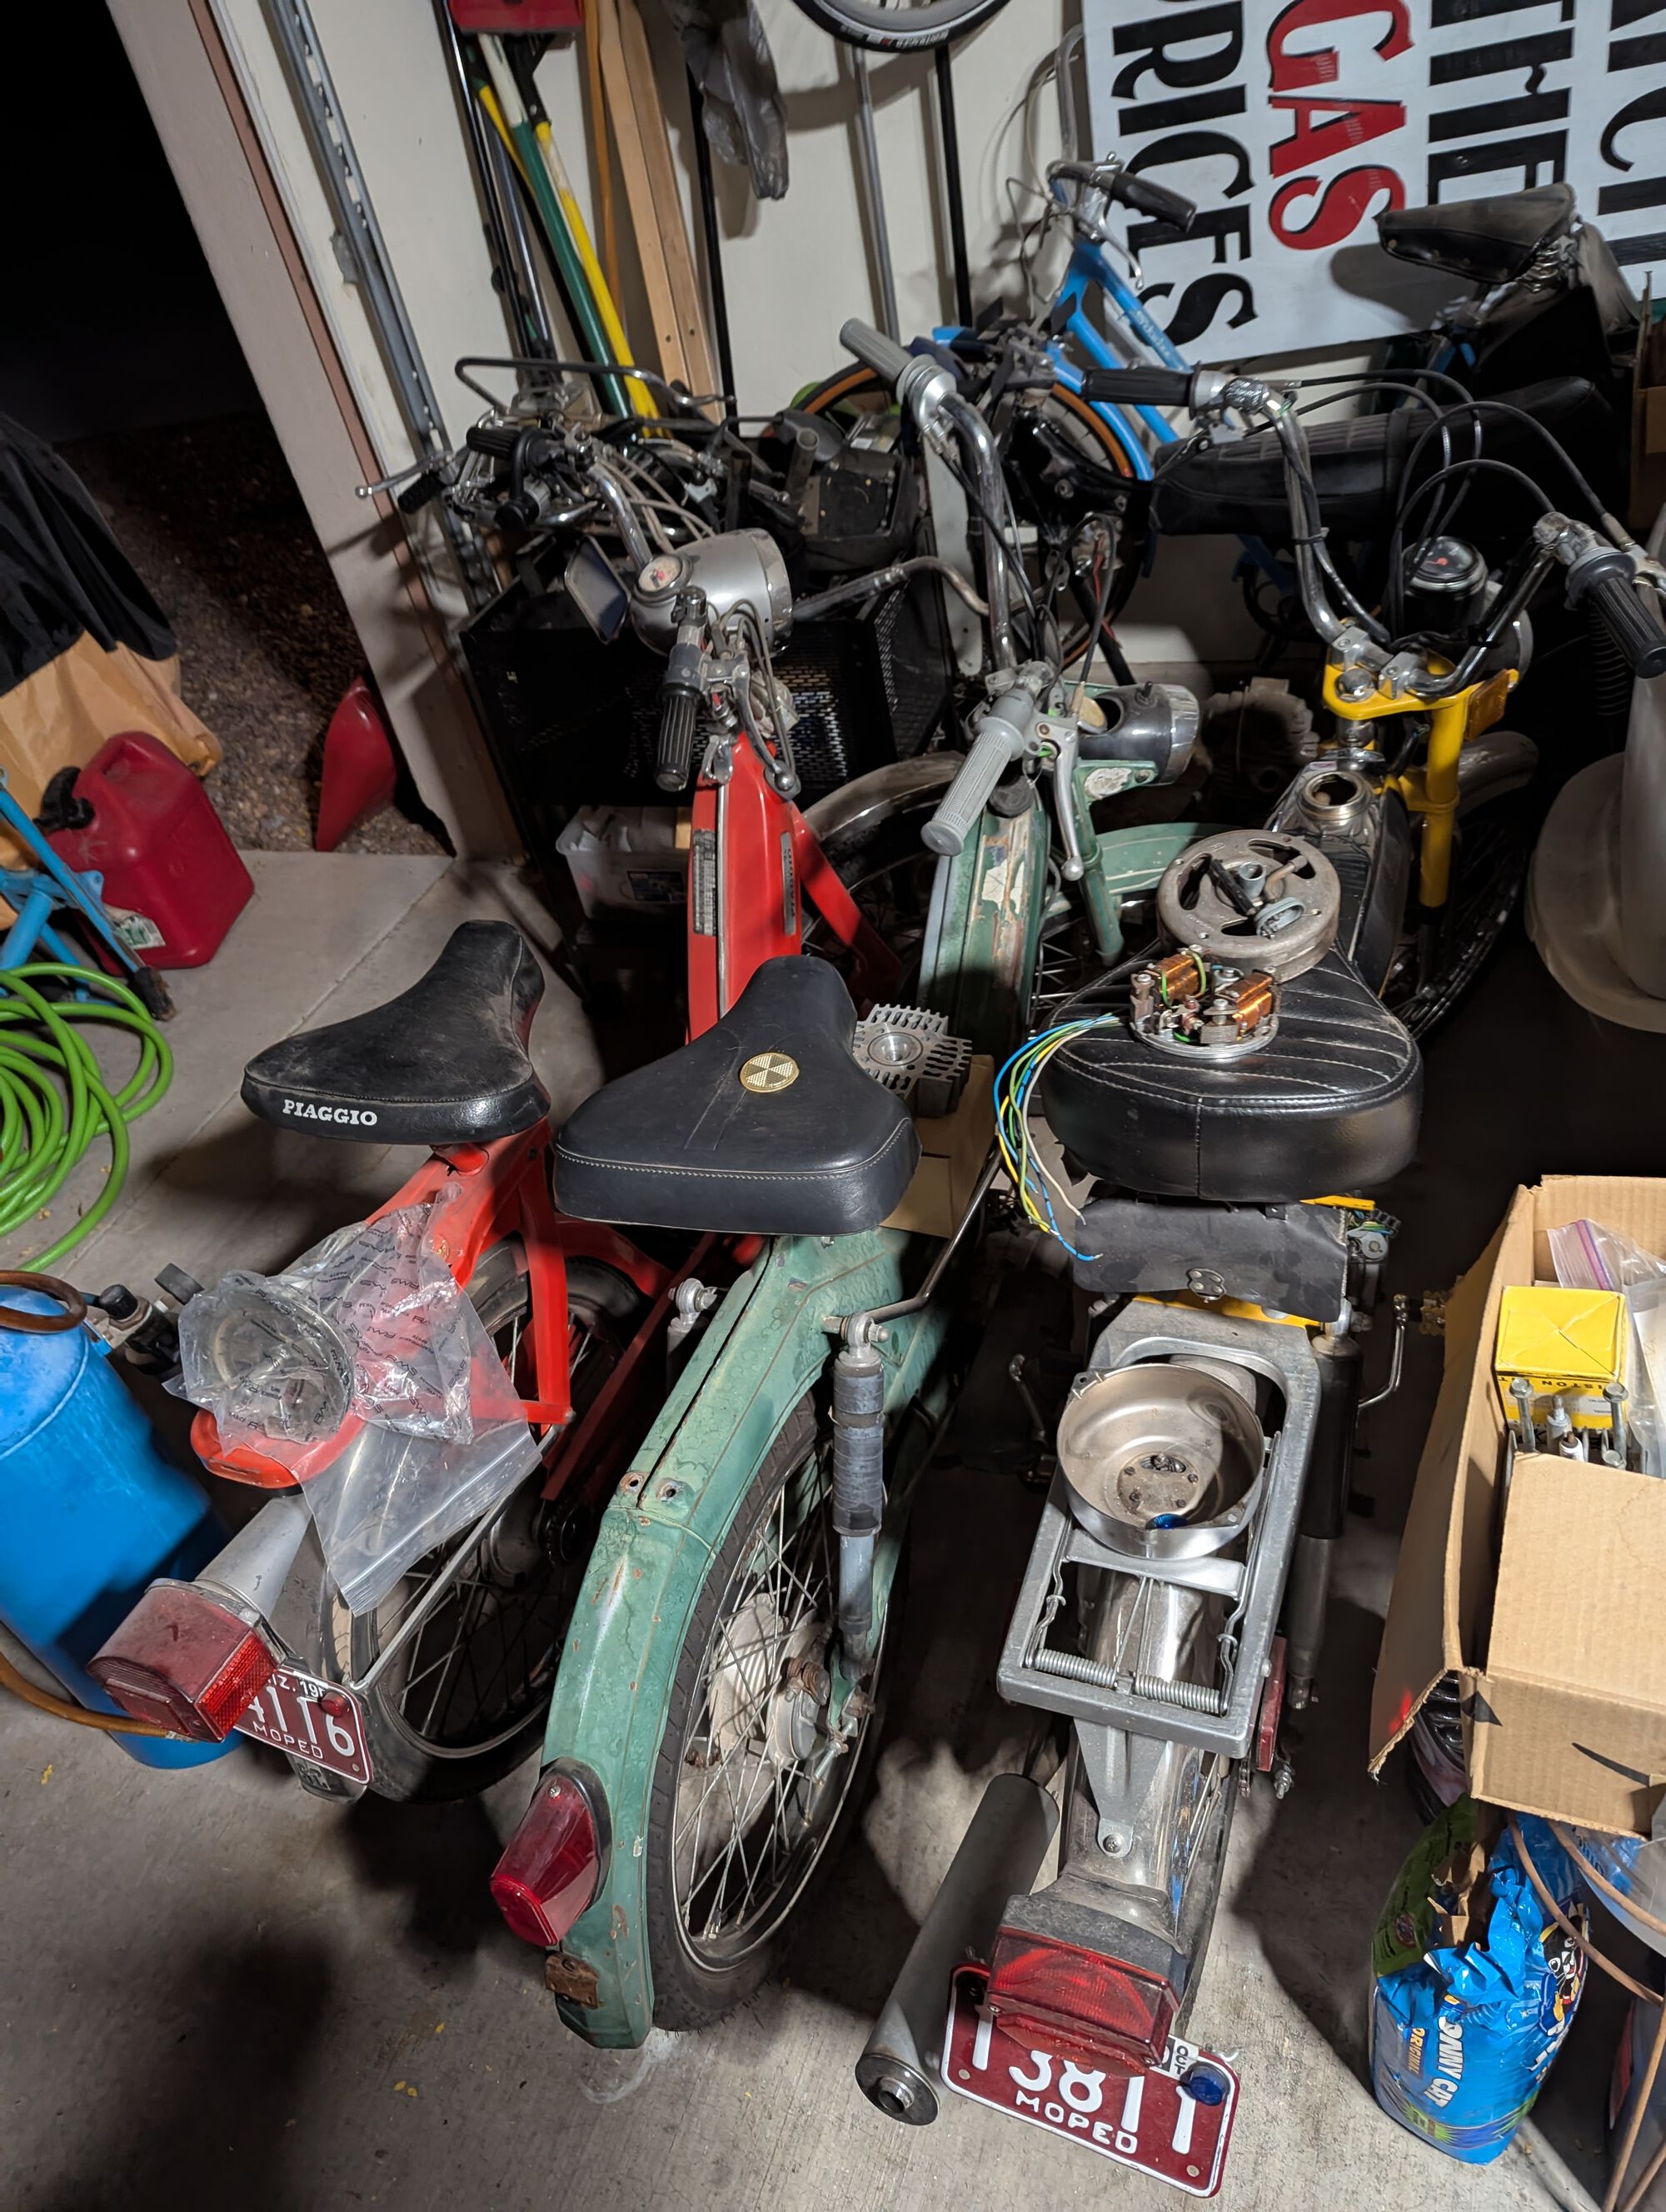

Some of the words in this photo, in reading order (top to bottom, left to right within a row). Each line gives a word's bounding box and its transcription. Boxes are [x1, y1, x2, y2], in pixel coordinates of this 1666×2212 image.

[1266, 0, 1415, 251] GAS
[1111, 0, 1258, 347] RICES
[282, 1099, 377, 1126] PIAGGIO
[1541, 1380, 1603, 1390] ISTON
[252, 1721, 324, 1759] MOPED
[1174, 2045, 1189, 2075] OCT
[1424, 2078, 1459, 2108] CAT
[1015, 2090, 1138, 2155] MOPED
